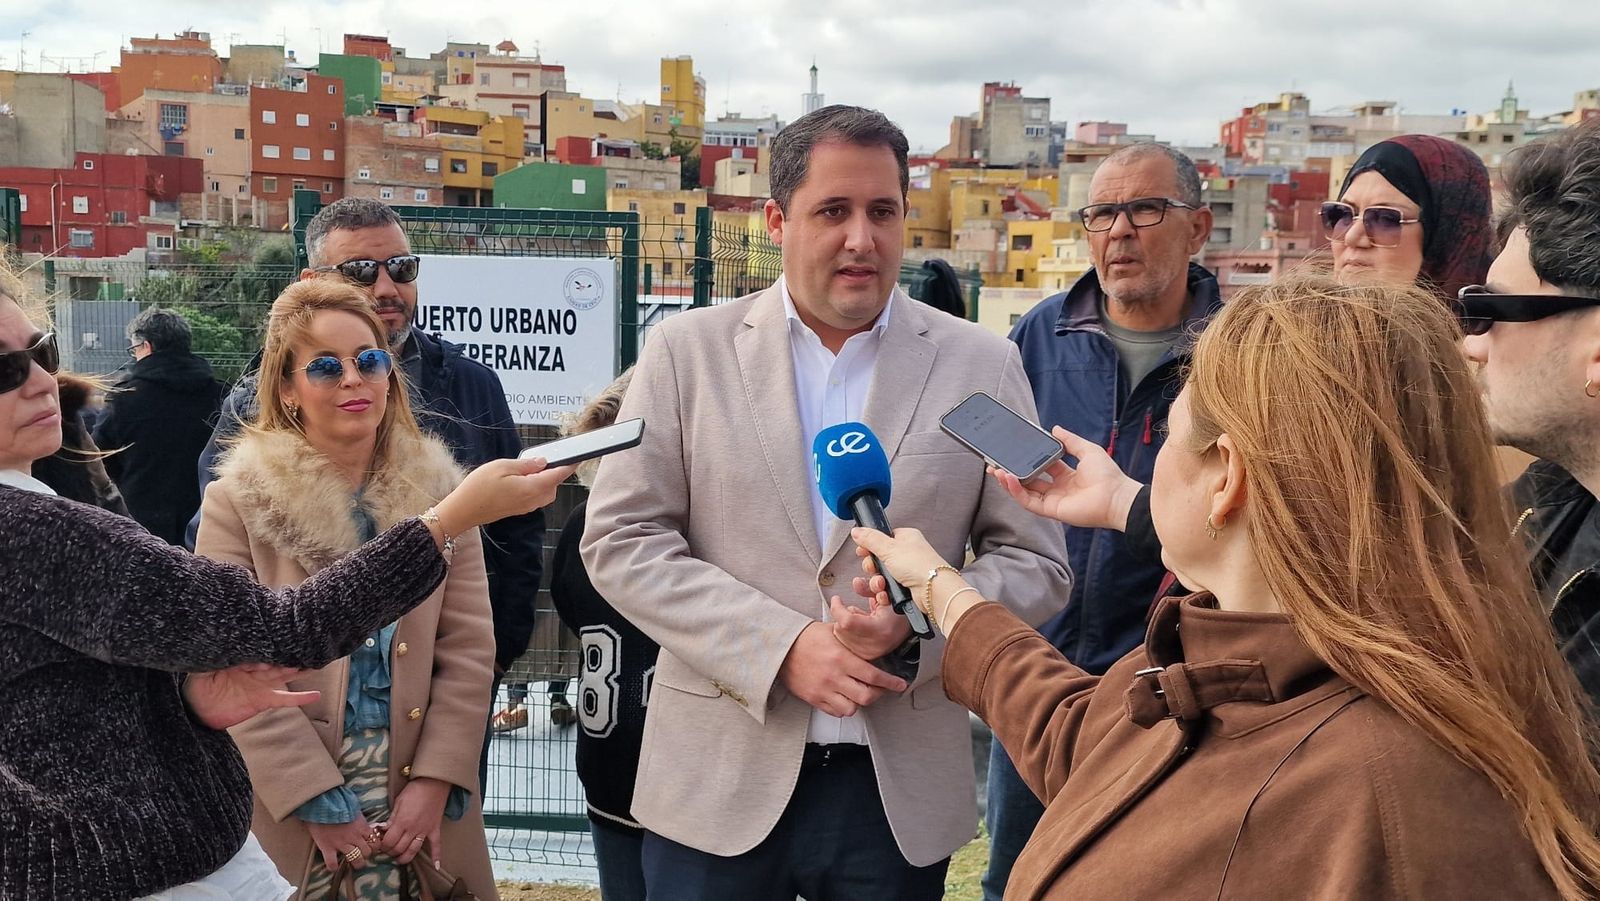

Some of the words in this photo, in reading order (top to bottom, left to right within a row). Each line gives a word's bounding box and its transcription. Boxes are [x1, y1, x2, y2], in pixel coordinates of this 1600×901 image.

[414, 305, 482, 332] UERTO
[490, 307, 577, 336] URBANO
[461, 343, 565, 372] PERANZA
[503, 393, 526, 404] DIO
[528, 394, 588, 407] AMBIENT
[516, 409, 525, 419] Y
[577, 624, 622, 739] 8
